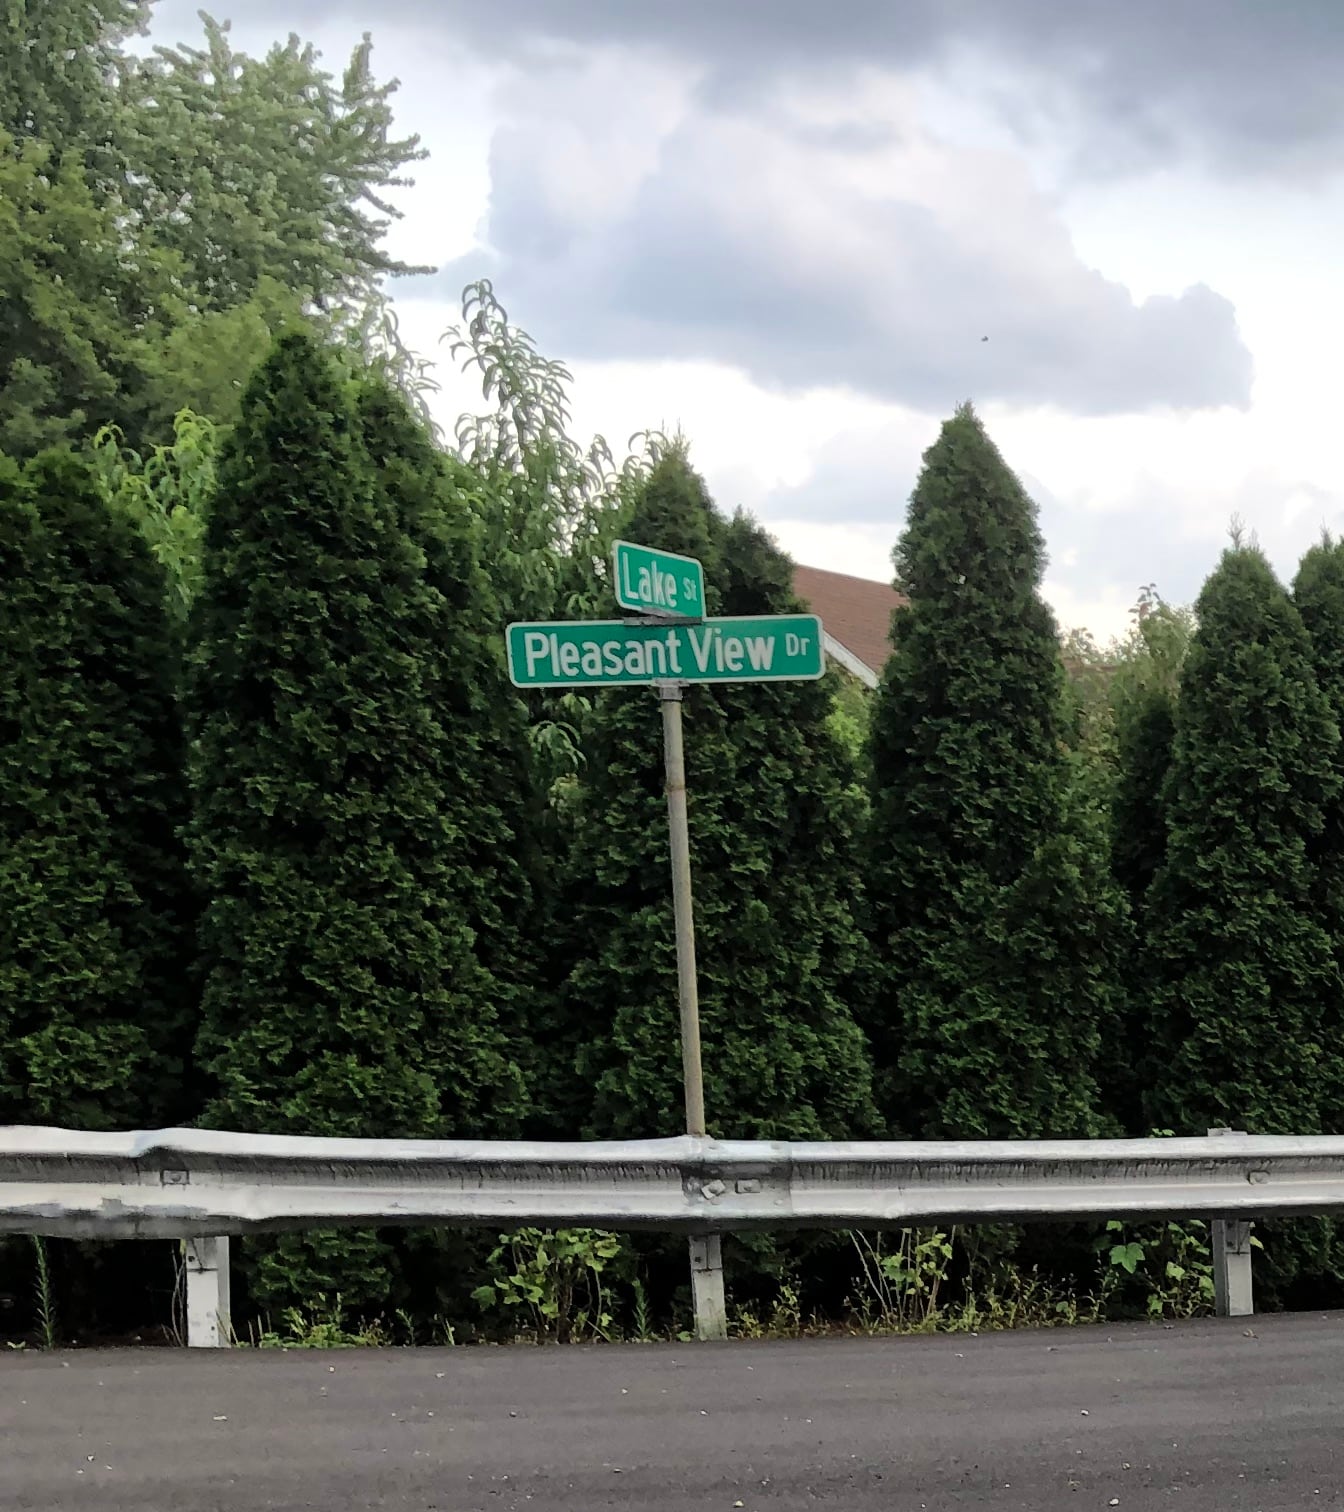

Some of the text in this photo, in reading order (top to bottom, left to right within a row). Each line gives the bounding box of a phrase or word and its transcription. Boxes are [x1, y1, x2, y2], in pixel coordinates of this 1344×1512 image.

[622, 552, 698, 607] Lake St
[524, 628, 810, 677] Pleasant View Dr
